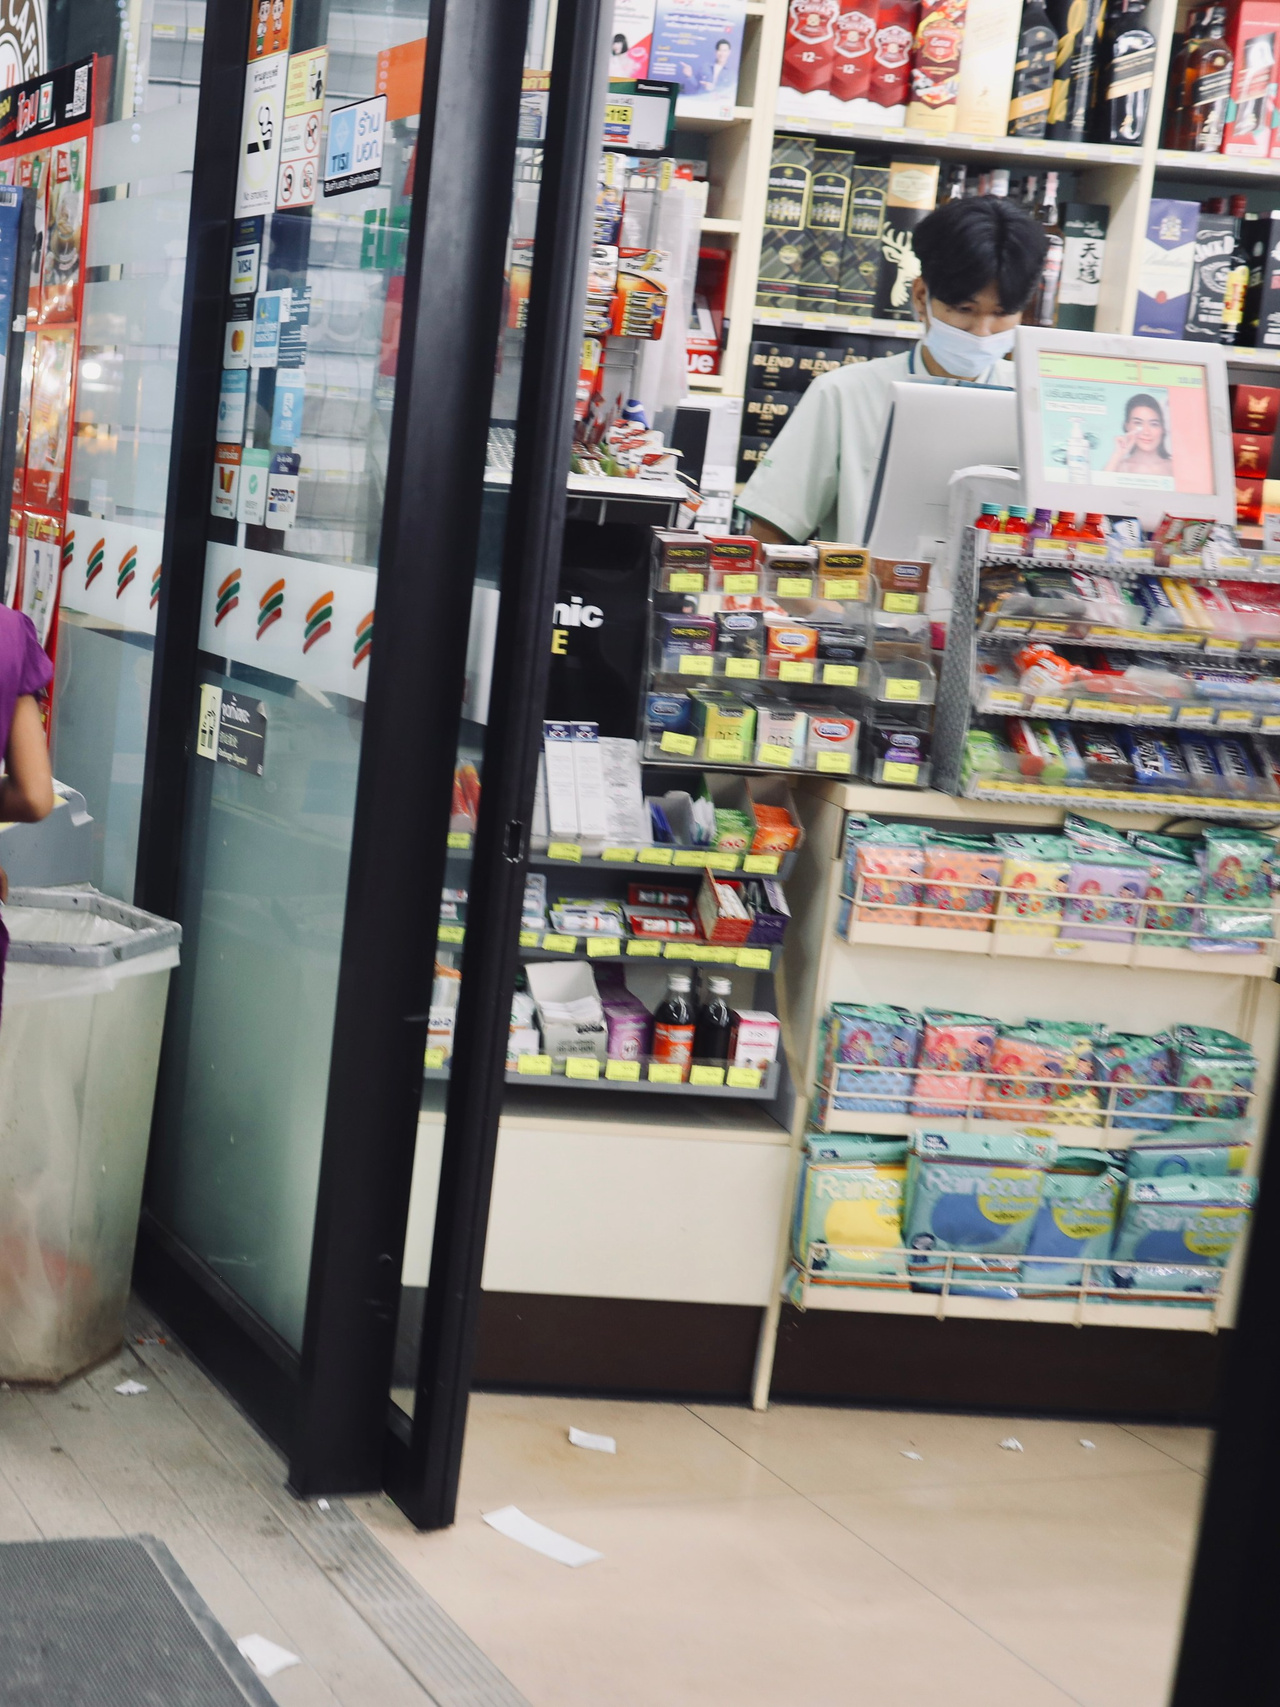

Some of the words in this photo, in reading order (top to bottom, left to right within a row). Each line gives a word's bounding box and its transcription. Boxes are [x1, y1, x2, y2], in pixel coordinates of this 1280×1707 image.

[801, 51, 816, 63] 12
[842, 63, 856, 74] 12
[1076, 242, 1101, 285] 天道
[752, 354, 795, 369] BLEND
[799, 358, 841, 372] BLEND
[747, 402, 789, 416] BLEND
[815, 1173, 902, 1201] Rainco
